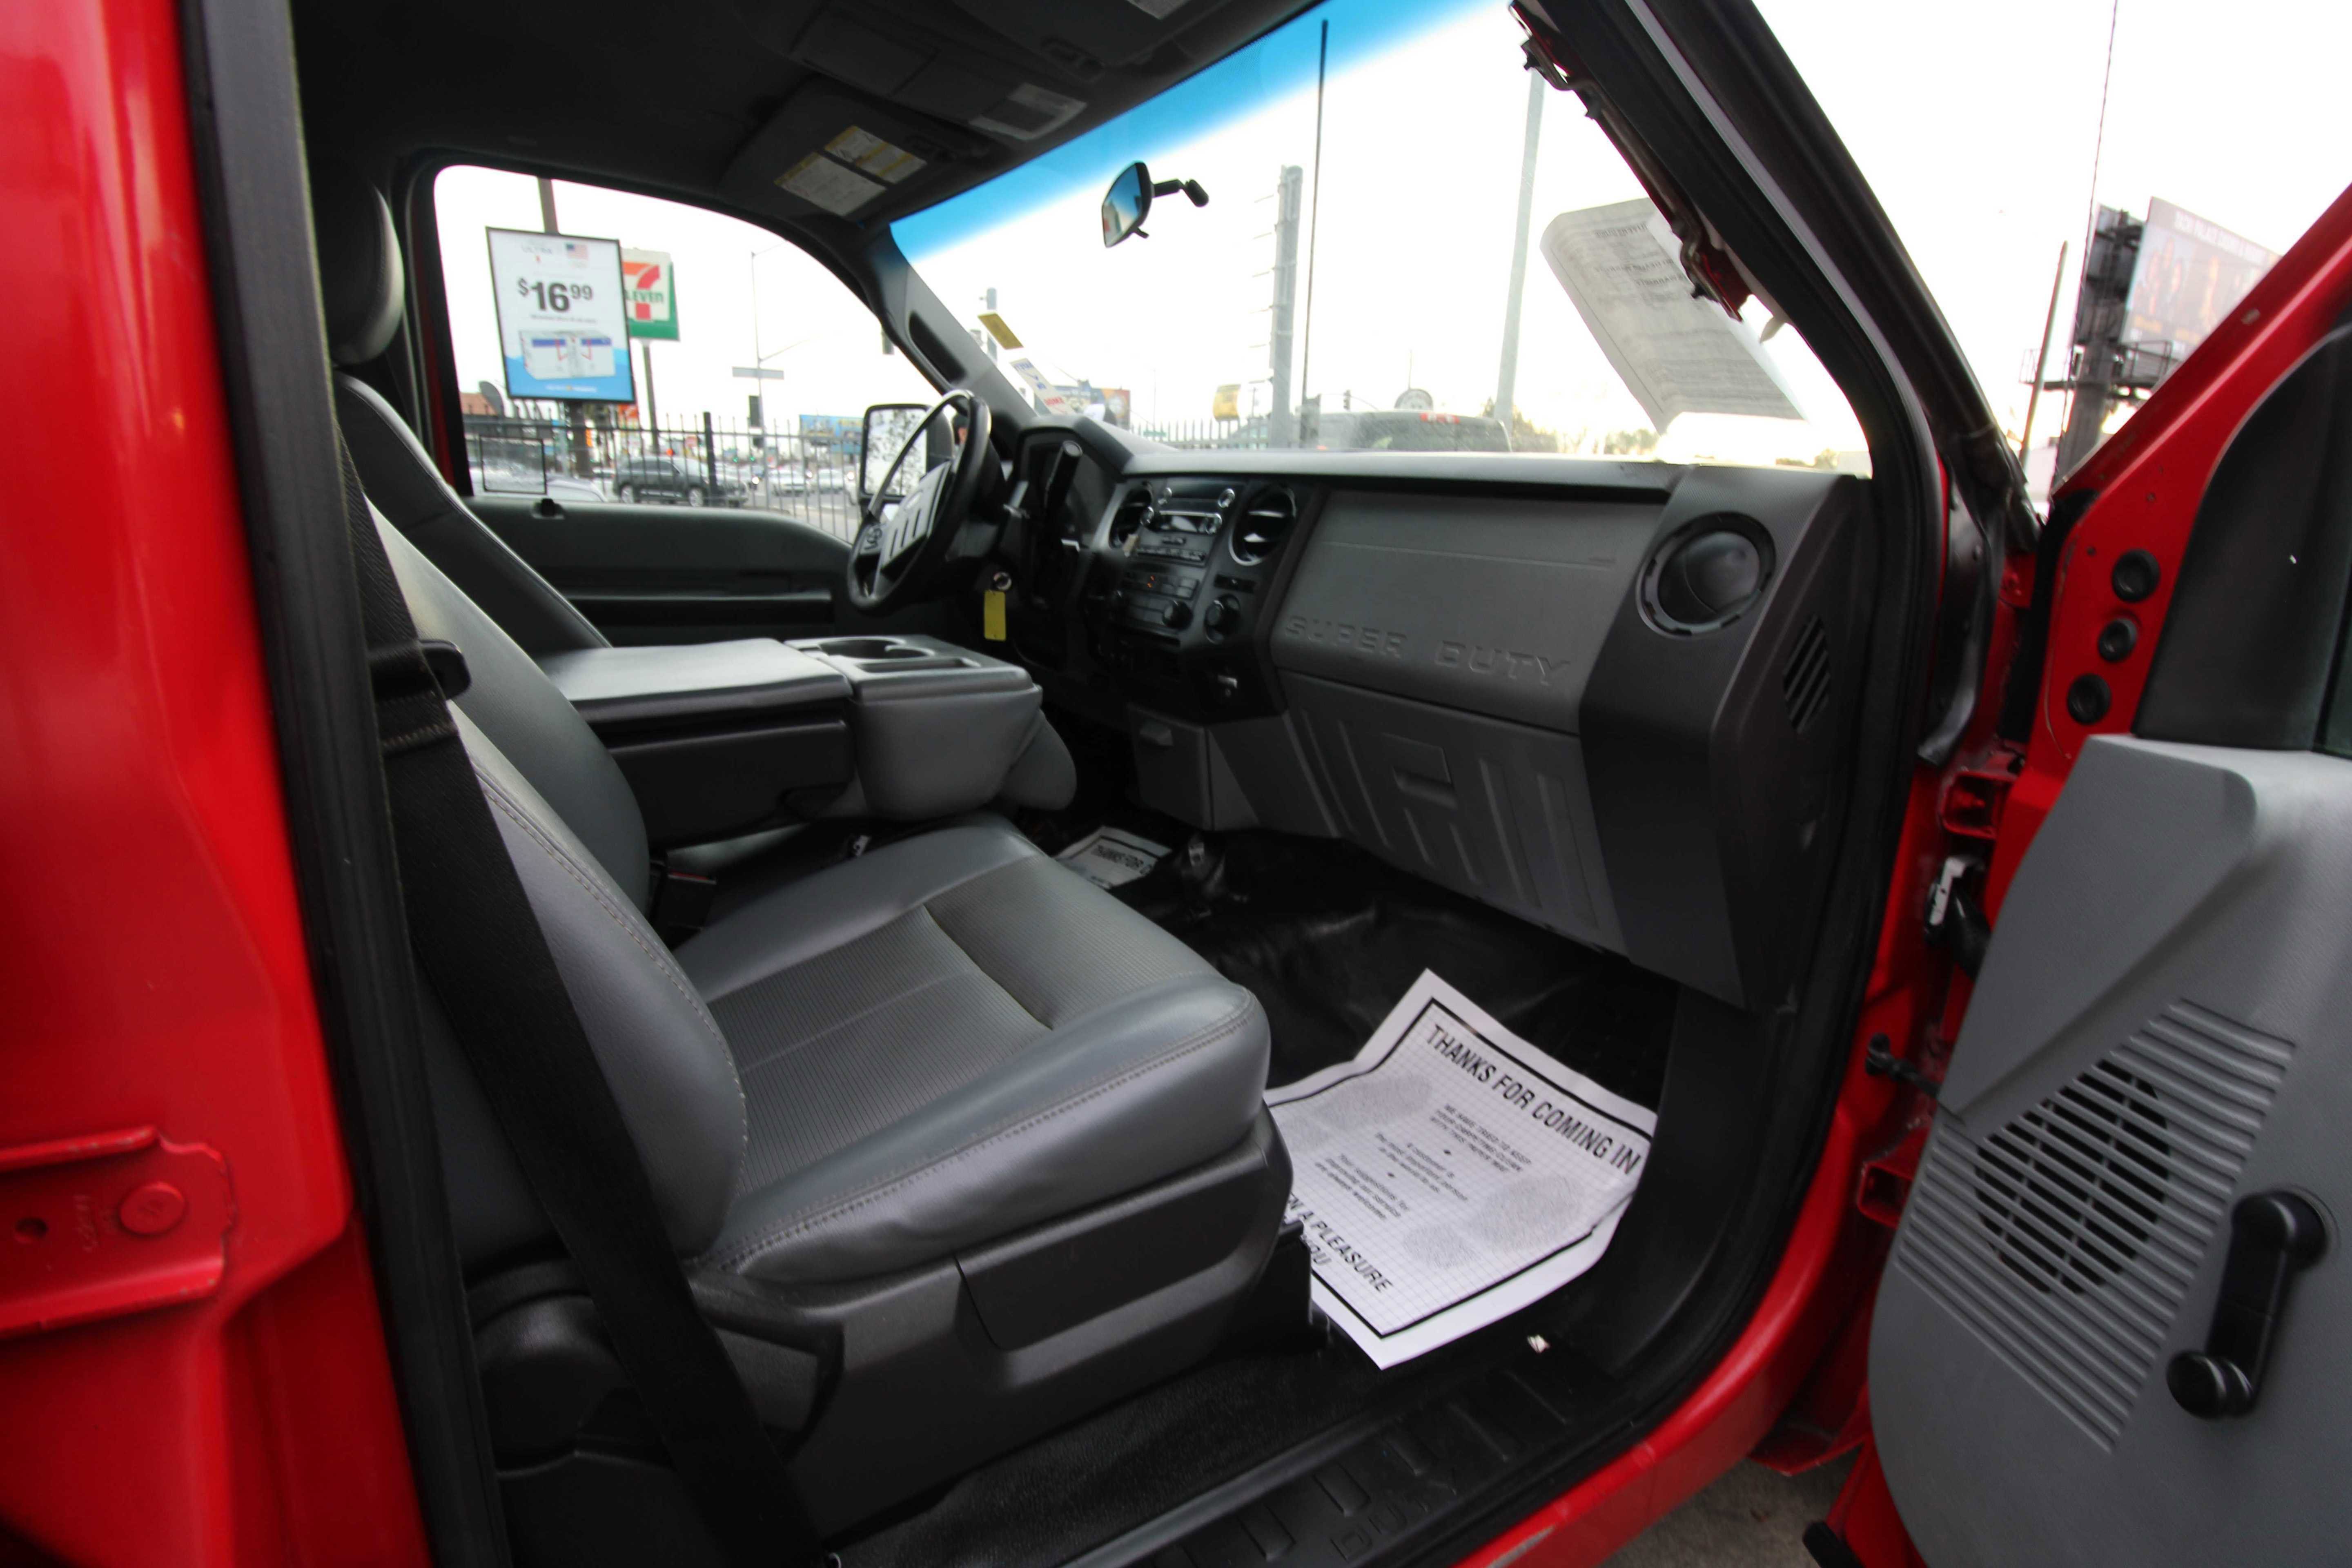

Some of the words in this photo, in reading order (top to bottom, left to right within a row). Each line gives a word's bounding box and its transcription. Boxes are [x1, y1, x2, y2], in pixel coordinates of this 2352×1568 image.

[1285, 615, 1407, 658] SUPER
[1434, 639, 1571, 686] DUTY
[1427, 1024, 1497, 1083] THANKS
[1492, 1074, 1535, 1110] FOR
[1532, 1100, 1613, 1158] COMING
[1610, 1143, 1642, 1175] IN
[1297, 1211, 1314, 1220] A
[1310, 1221, 1393, 1292] PLEASURE
